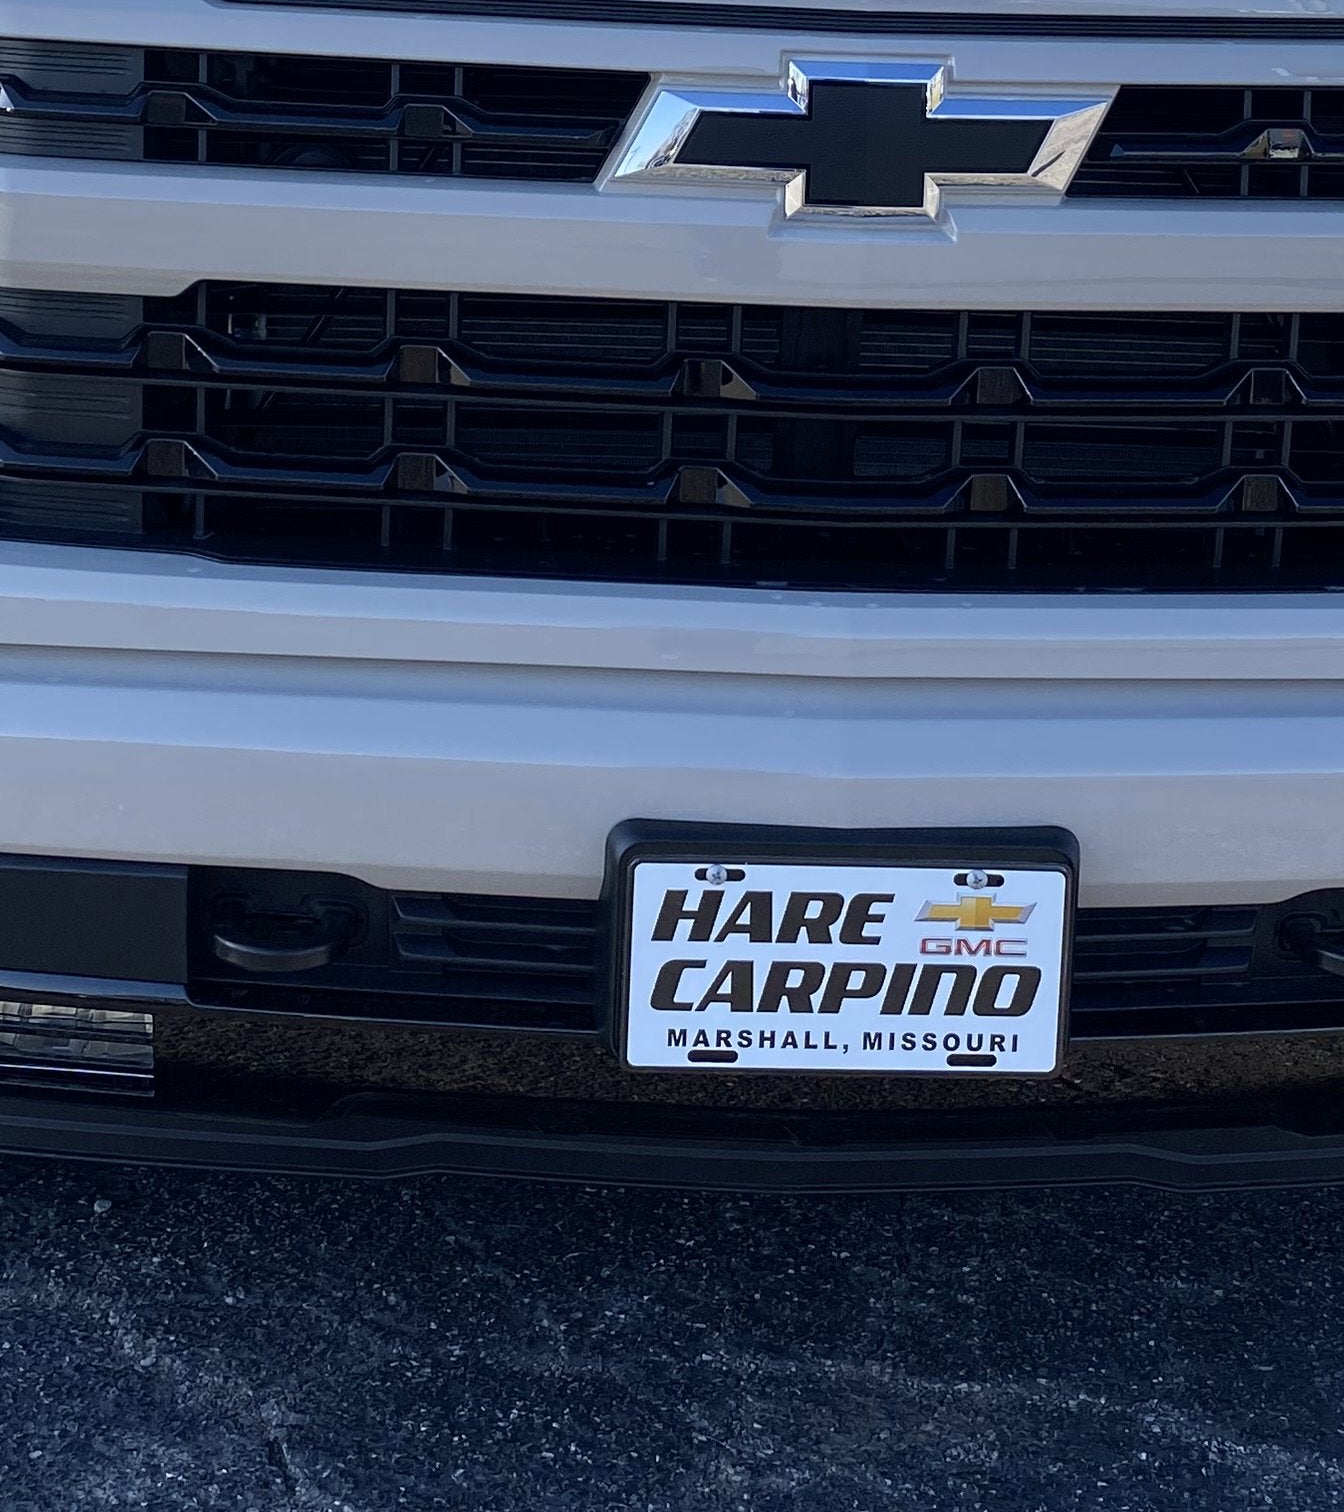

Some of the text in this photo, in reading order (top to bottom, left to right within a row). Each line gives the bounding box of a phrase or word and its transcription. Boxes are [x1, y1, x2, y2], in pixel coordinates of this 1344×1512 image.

[651, 889, 896, 945] HARE
[919, 937, 1029, 958] GMC
[650, 959, 1042, 1017] CARPINO
[667, 1029, 1019, 1054] MARSHALL, MISSOURI
